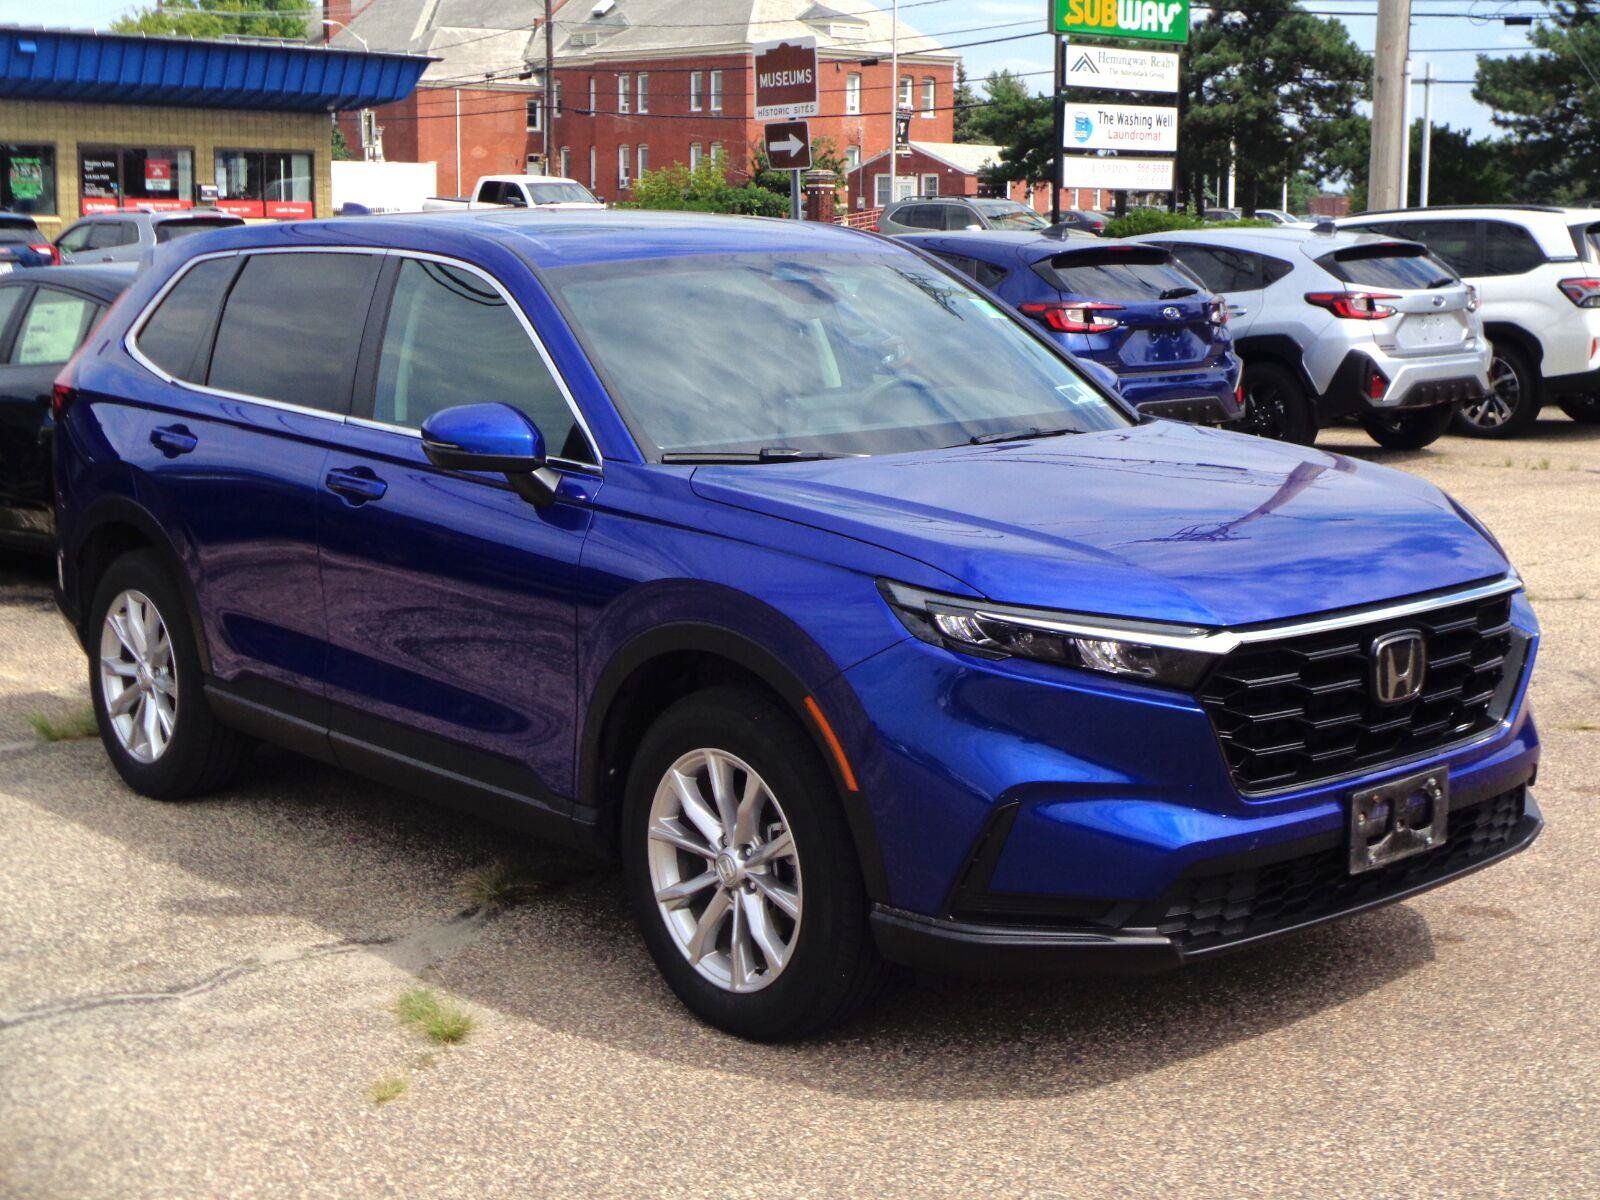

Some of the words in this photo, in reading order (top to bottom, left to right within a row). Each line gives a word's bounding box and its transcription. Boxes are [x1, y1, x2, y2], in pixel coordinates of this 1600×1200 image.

[1064, 0, 1182, 33] SUBWAY
[1097, 51, 1147, 66] Hemingway
[1150, 56, 1175, 69] Realty
[759, 69, 812, 88] MUSEUMS
[758, 107, 790, 117] HISTORIC
[794, 105, 815, 114] SITES
[1097, 111, 1114, 125] The
[1116, 112, 1153, 129] Washing
[1155, 113, 1173, 127] Well
[1108, 129, 1161, 142] Laundromat
